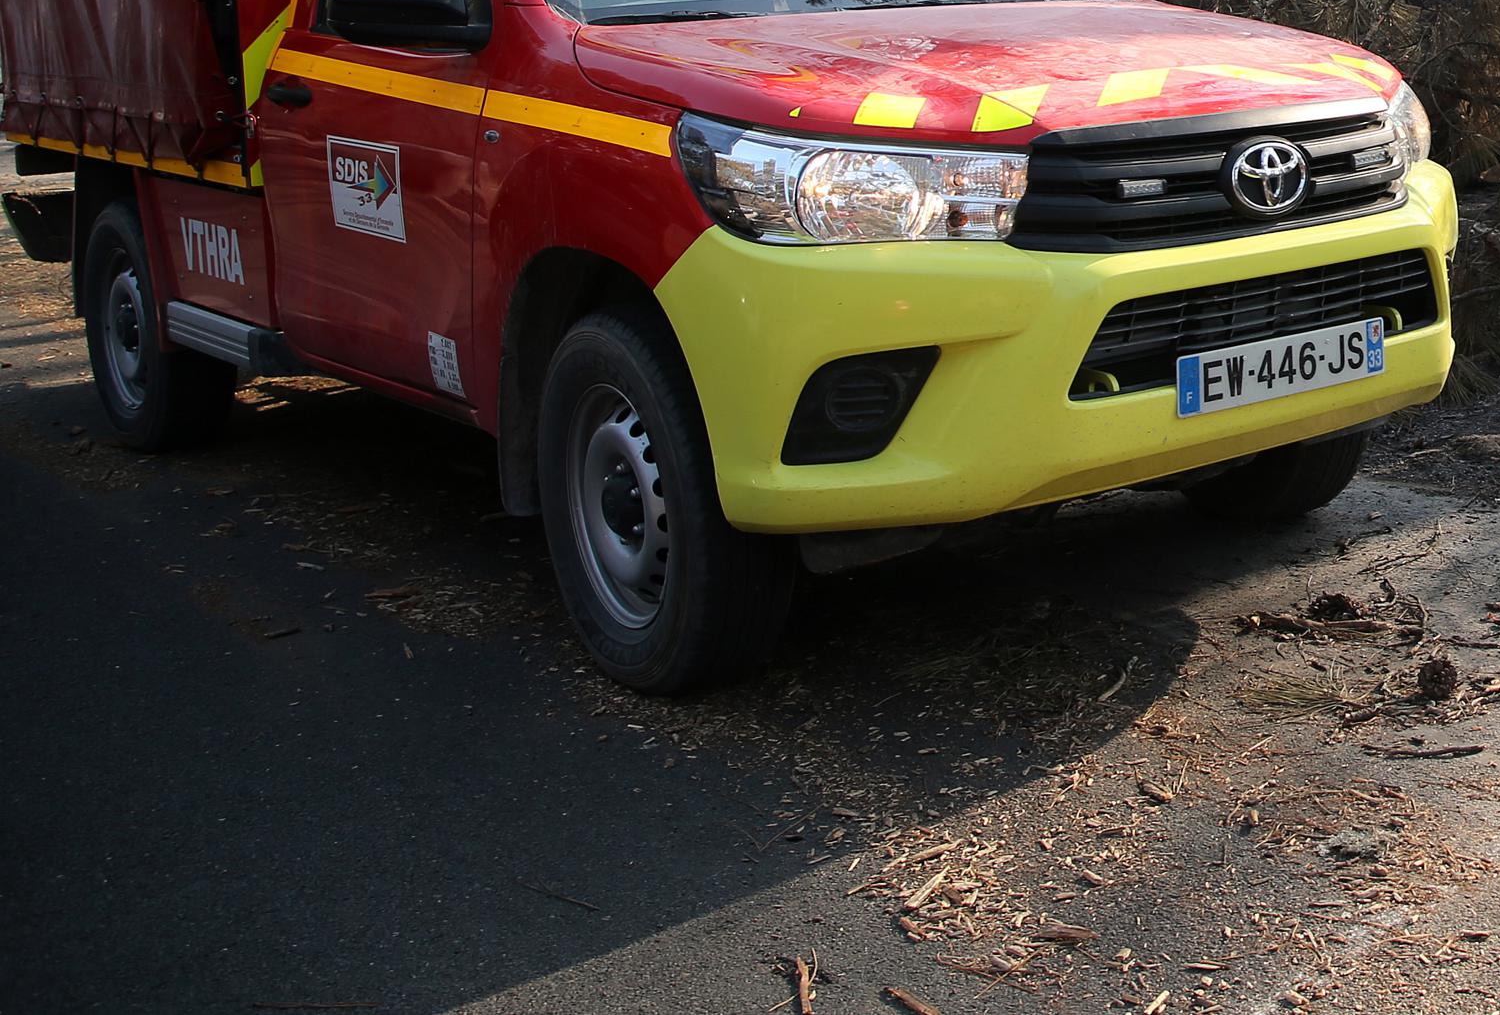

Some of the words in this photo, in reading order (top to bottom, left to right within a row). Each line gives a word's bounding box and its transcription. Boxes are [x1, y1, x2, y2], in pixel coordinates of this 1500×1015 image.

[335, 156, 369, 183] SDIS
[359, 192, 373, 207] 33
[180, 216, 245, 286] VTHRA
[1203, 331, 1365, 403] EW-446-JS
[1368, 348, 1382, 368] 33
[1186, 391, 1193, 404] F
